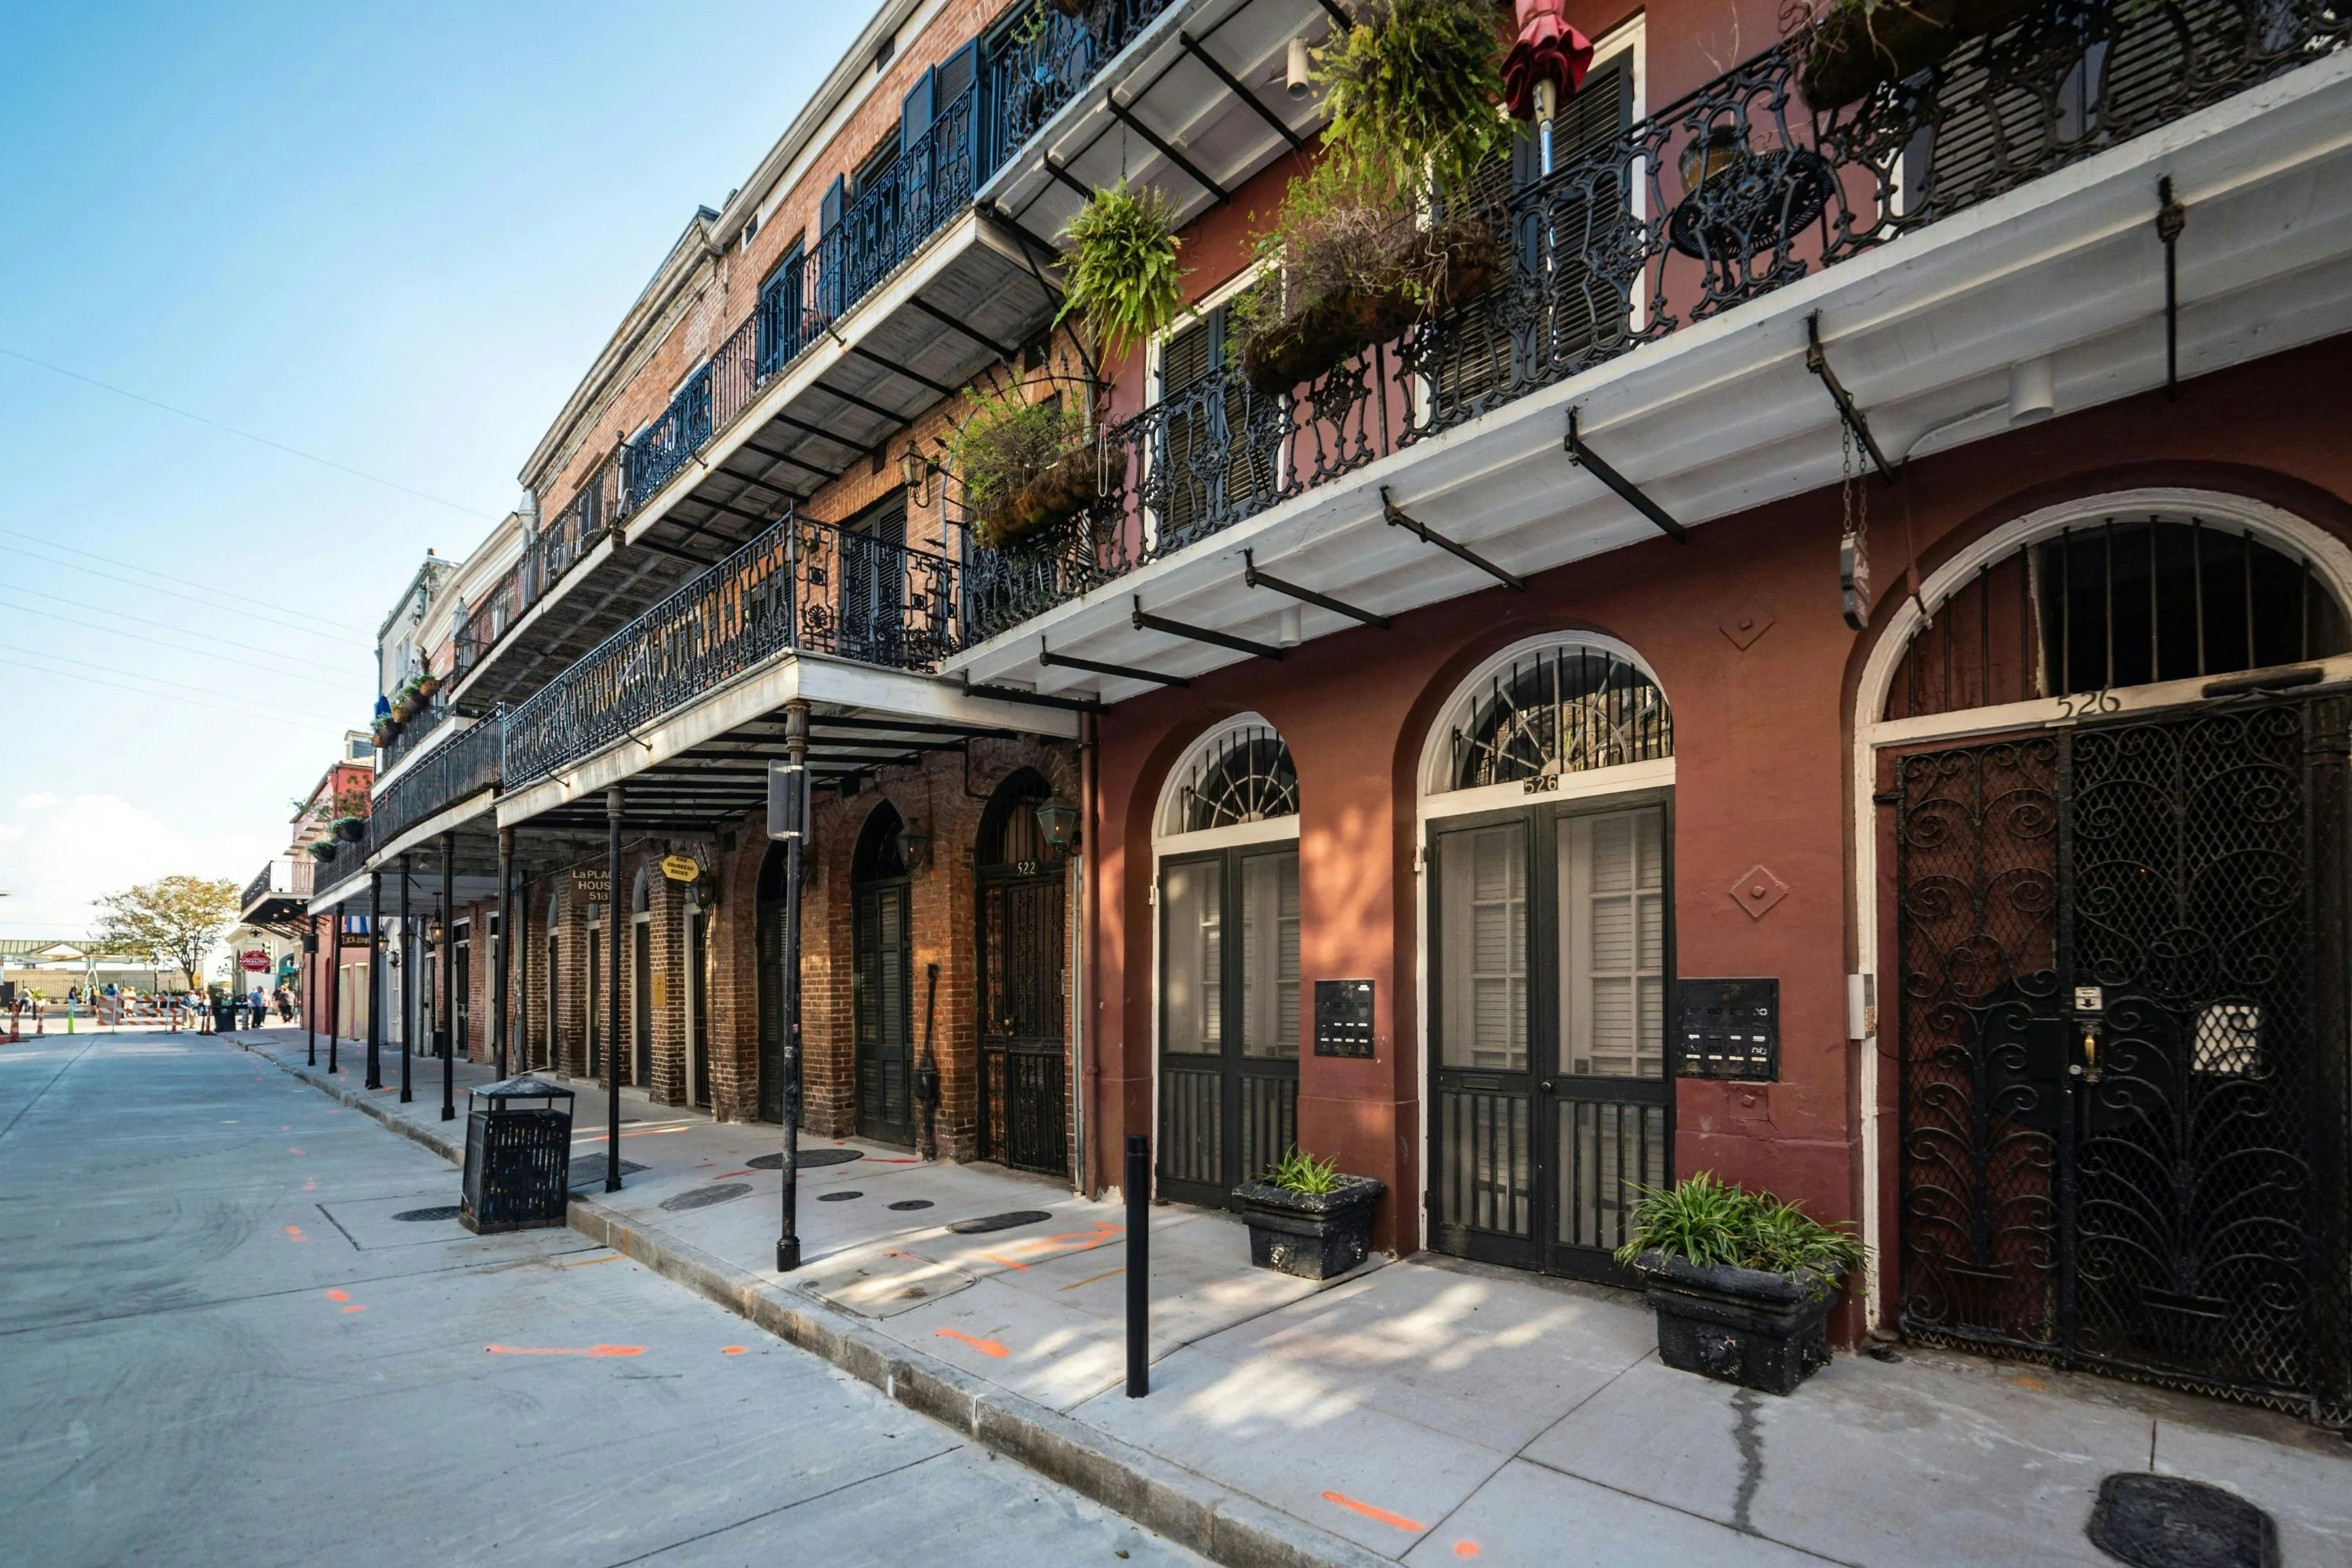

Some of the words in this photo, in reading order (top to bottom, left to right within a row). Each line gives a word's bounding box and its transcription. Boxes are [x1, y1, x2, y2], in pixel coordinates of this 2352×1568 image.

[2057, 684, 2121, 719] 526
[1523, 775, 1557, 794] 526
[1018, 862, 1035, 876] 522
[578, 880, 612, 891] HOUS
[589, 891, 608, 901] 518
